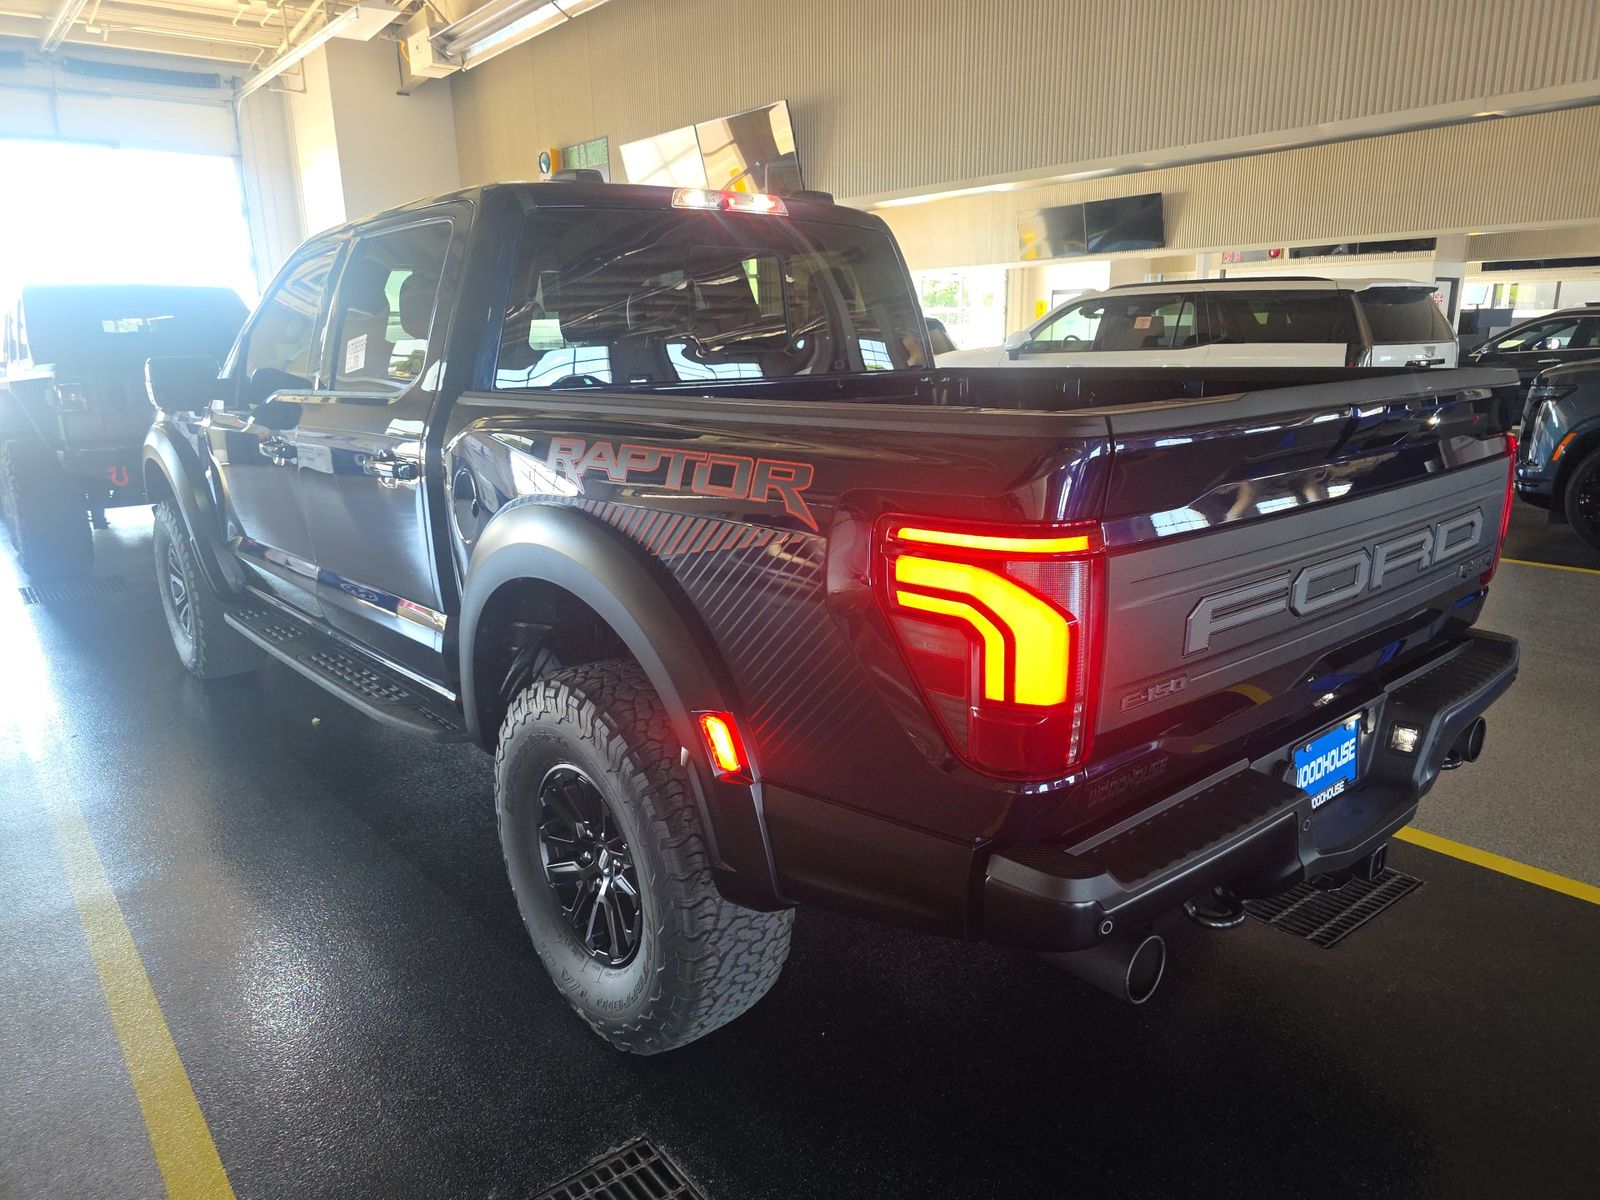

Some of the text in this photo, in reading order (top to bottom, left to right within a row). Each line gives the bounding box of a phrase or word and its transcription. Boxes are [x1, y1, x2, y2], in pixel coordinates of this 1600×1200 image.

[547, 437, 819, 532] RAPTOR
[1183, 507, 1483, 657] FORD
[1119, 675, 1187, 712] F-150
[1311, 780, 1345, 809] OODHOUSE
